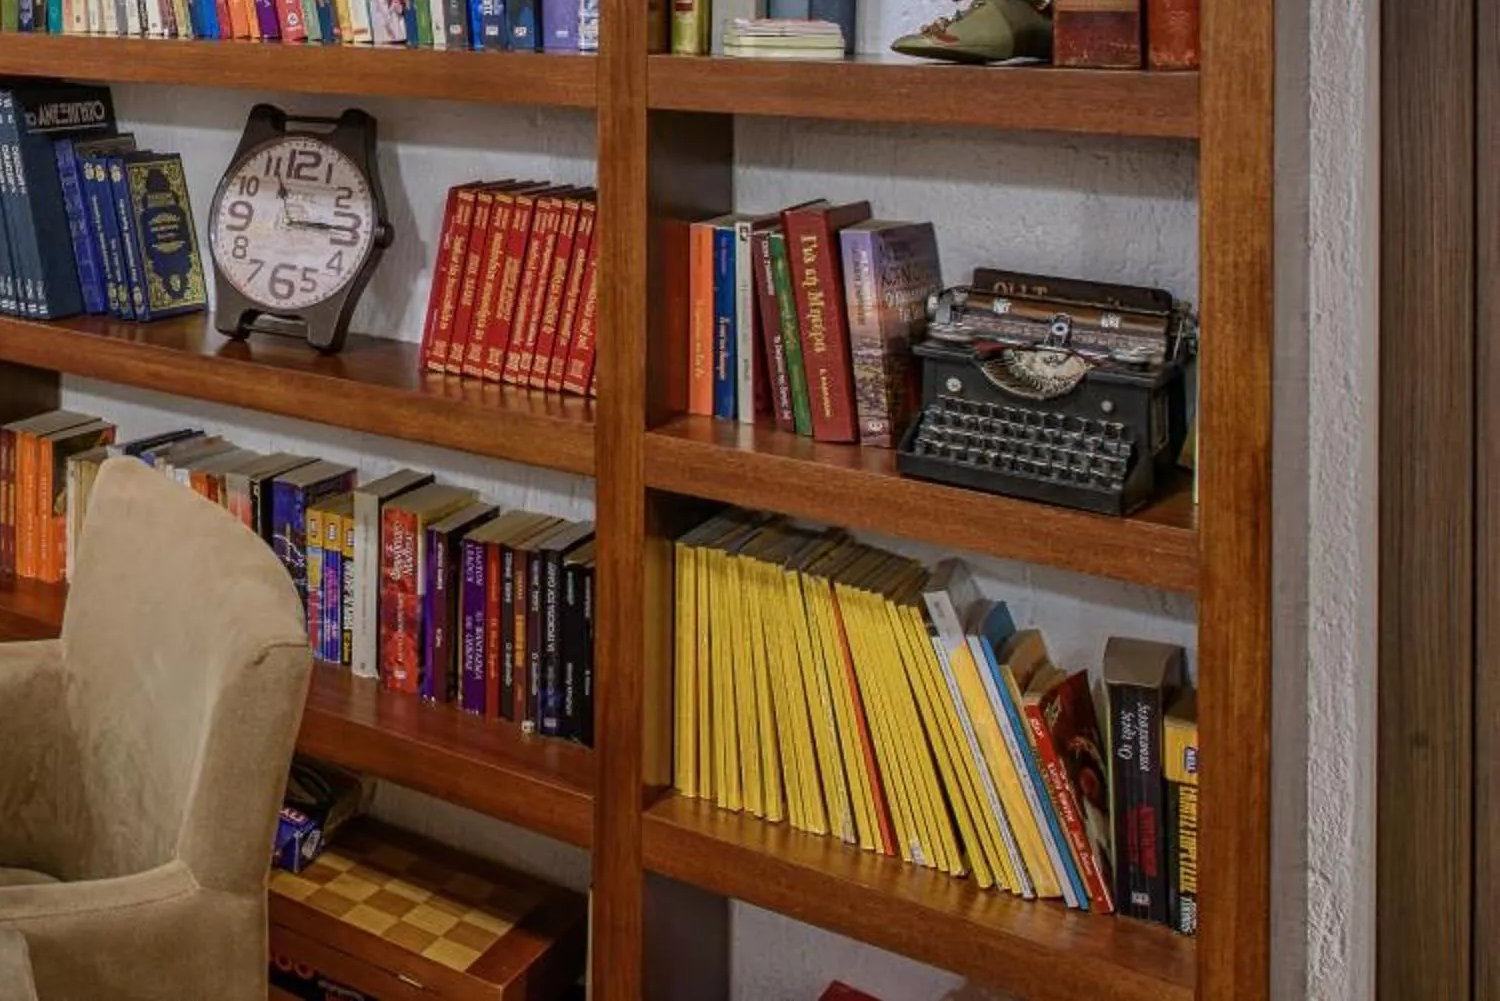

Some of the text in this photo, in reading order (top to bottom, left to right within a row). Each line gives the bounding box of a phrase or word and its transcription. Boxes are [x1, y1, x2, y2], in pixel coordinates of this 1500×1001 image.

[263, 154, 282, 177] 11
[285, 148, 322, 182] 12
[325, 162, 333, 184] 1
[238, 174, 260, 197] 10
[335, 186, 353, 209] 2
[225, 200, 254, 232] 9
[329, 210, 362, 247] 3
[232, 235, 249, 260] 8
[246, 258, 266, 283] 7
[326, 250, 343, 276] 4
[268, 262, 297, 300] 6
[299, 266, 319, 293] 5
